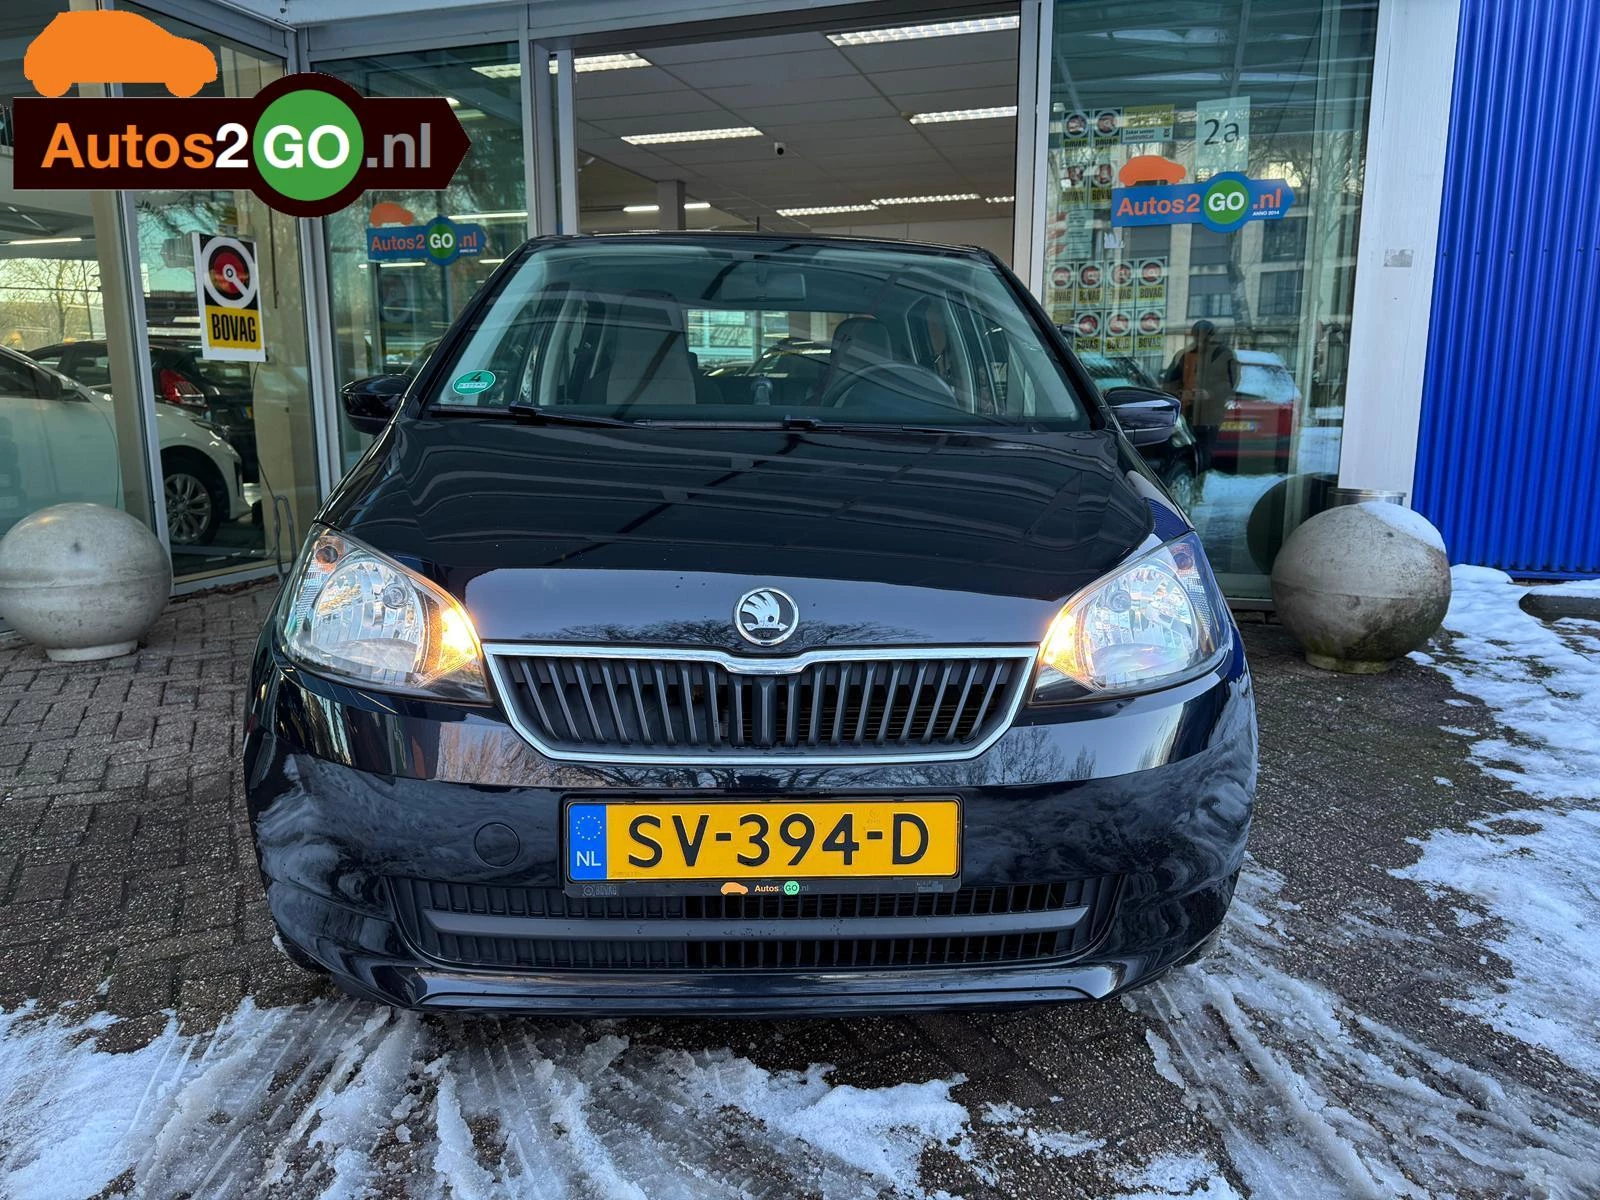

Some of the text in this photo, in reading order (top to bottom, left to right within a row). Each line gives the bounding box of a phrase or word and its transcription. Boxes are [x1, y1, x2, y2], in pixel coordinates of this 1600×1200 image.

[1203, 118, 1240, 146] 2a
[1140, 287, 1163, 298] BOVAG
[211, 313, 257, 343] BOVAG
[469, 371, 482, 382] 4
[628, 812, 929, 867] SV-394-D
[576, 850, 601, 867] NL
